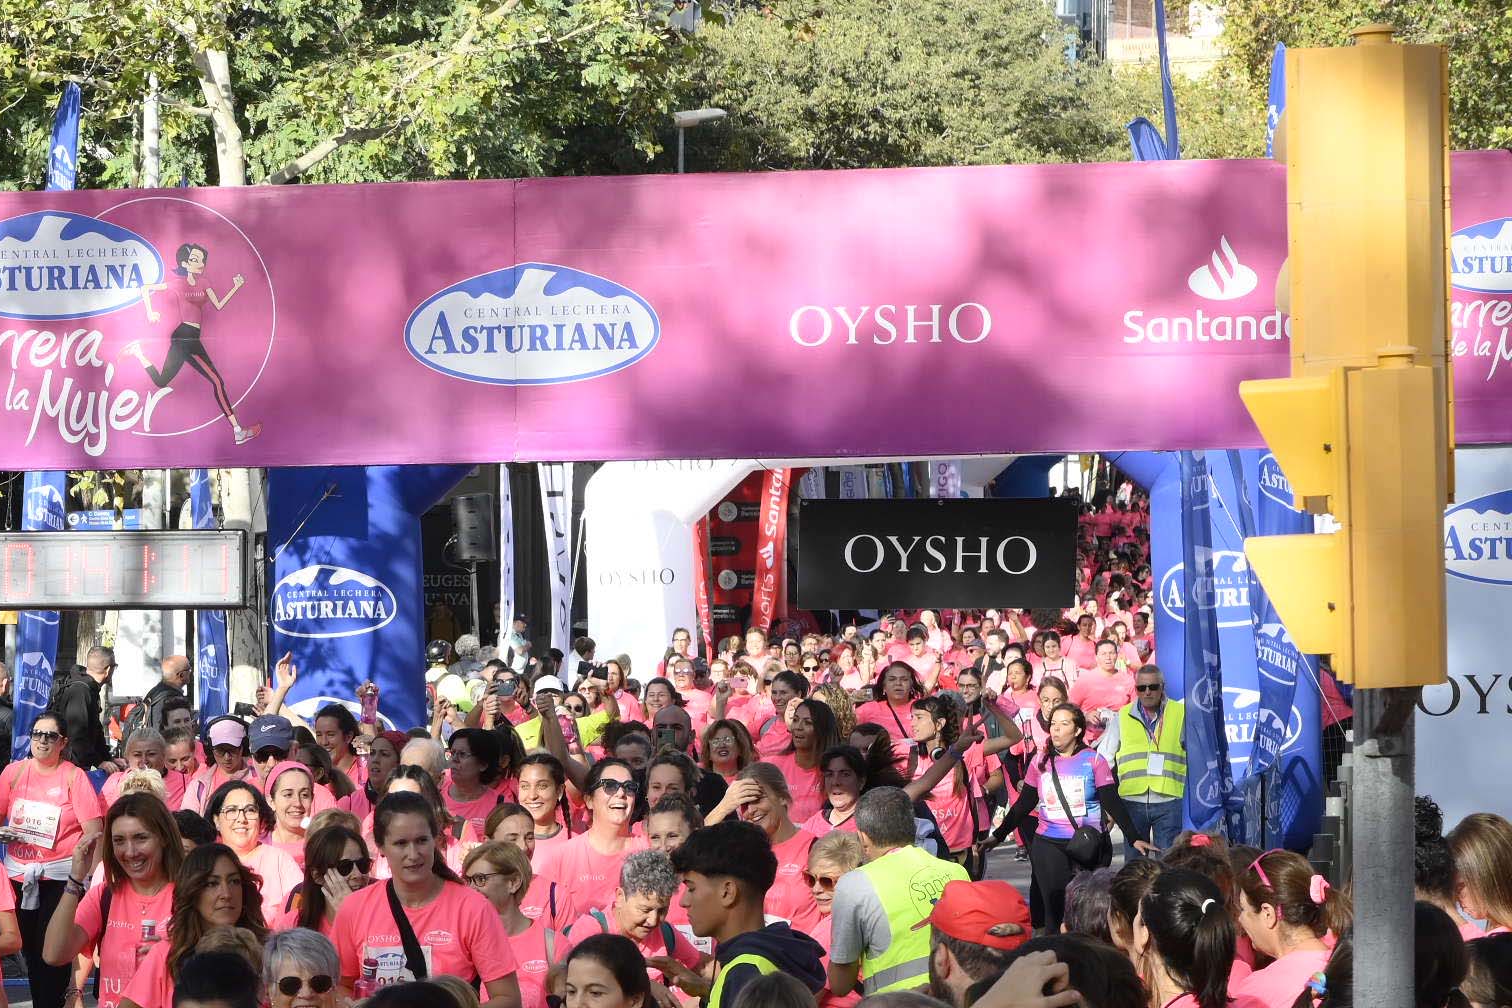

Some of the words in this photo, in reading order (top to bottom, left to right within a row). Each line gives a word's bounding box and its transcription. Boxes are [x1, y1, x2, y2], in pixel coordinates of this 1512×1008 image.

[66, 246, 139, 259] LECHERA
[464, 304, 542, 317] CENTRAL
[551, 303, 632, 316] LECHERA
[425, 310, 639, 356] ASTURIANA
[791, 301, 992, 346] OYSHO
[5, 372, 30, 411] la
[24, 359, 174, 457] Mujer
[844, 534, 1037, 574] OYSHO
[286, 589, 329, 598] CENTRAL
[334, 588, 383, 598] LECHERA
[275, 594, 387, 622] ASTURIANA
[368, 935, 400, 944] OYSHO
[103, 977, 122, 994] TU
